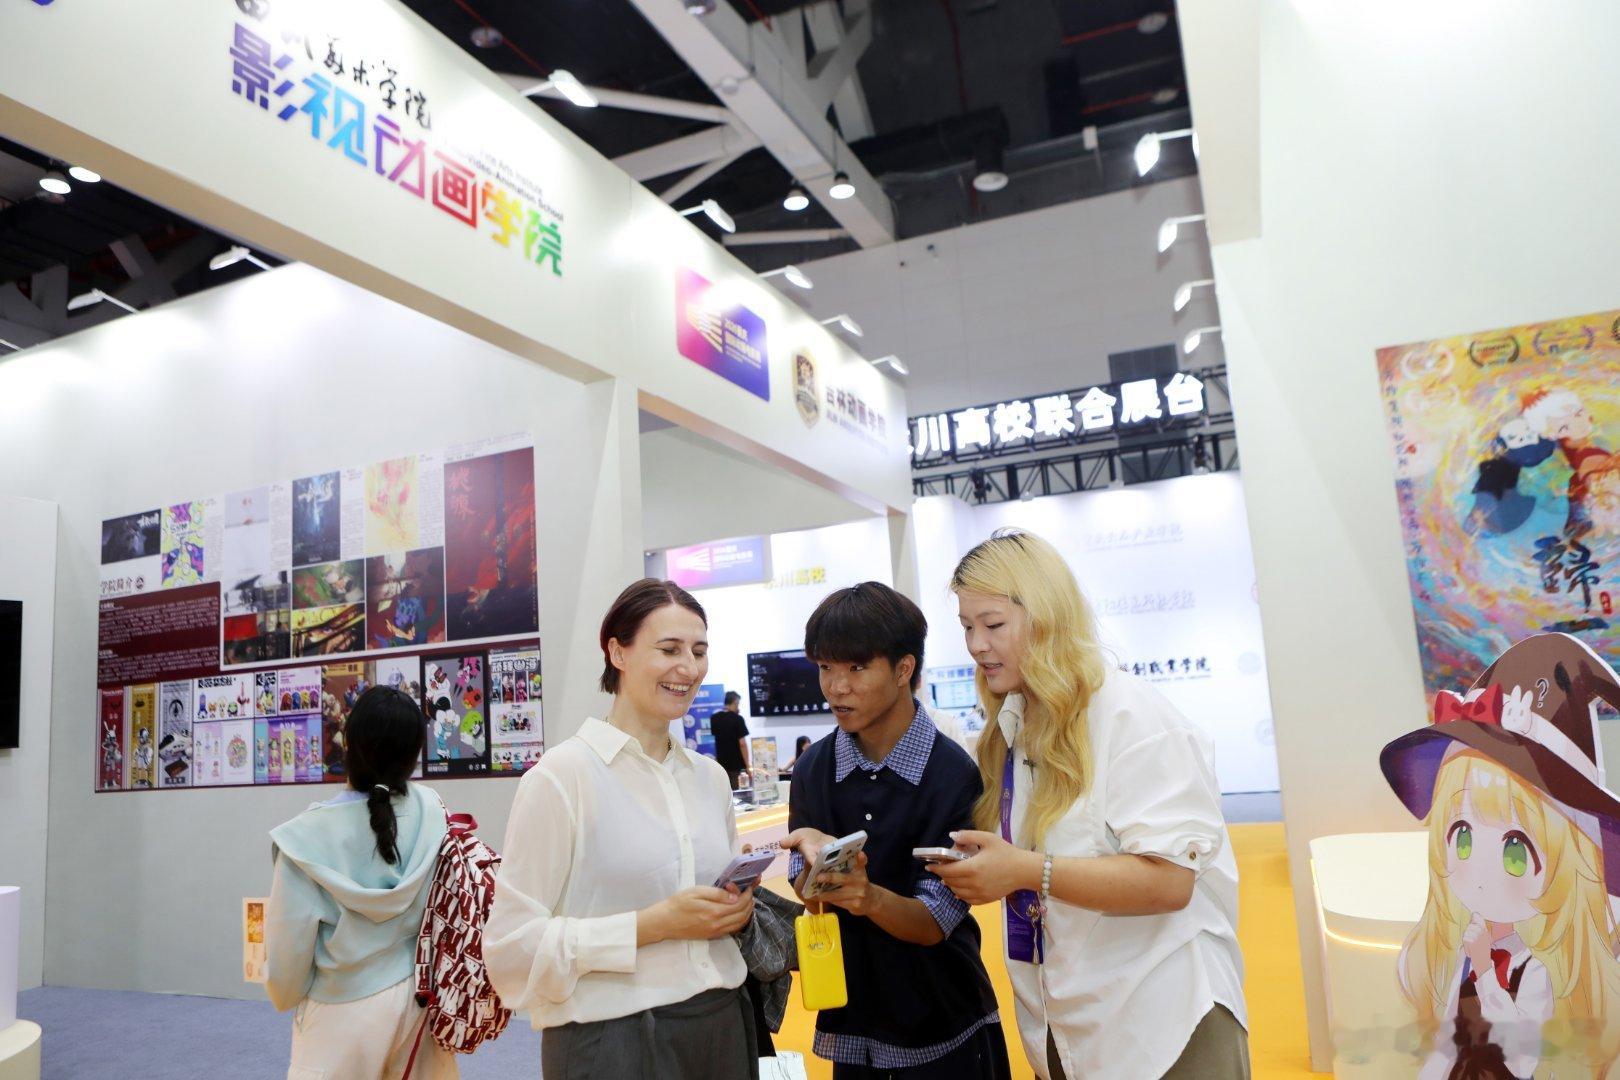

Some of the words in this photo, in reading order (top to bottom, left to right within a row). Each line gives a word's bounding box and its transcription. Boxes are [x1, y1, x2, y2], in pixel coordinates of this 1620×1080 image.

[229, 22, 563, 278] 影视动画学院
[906, 373, 1204, 455] 川高校联合展台
[1534, 678, 1550, 709] ?
